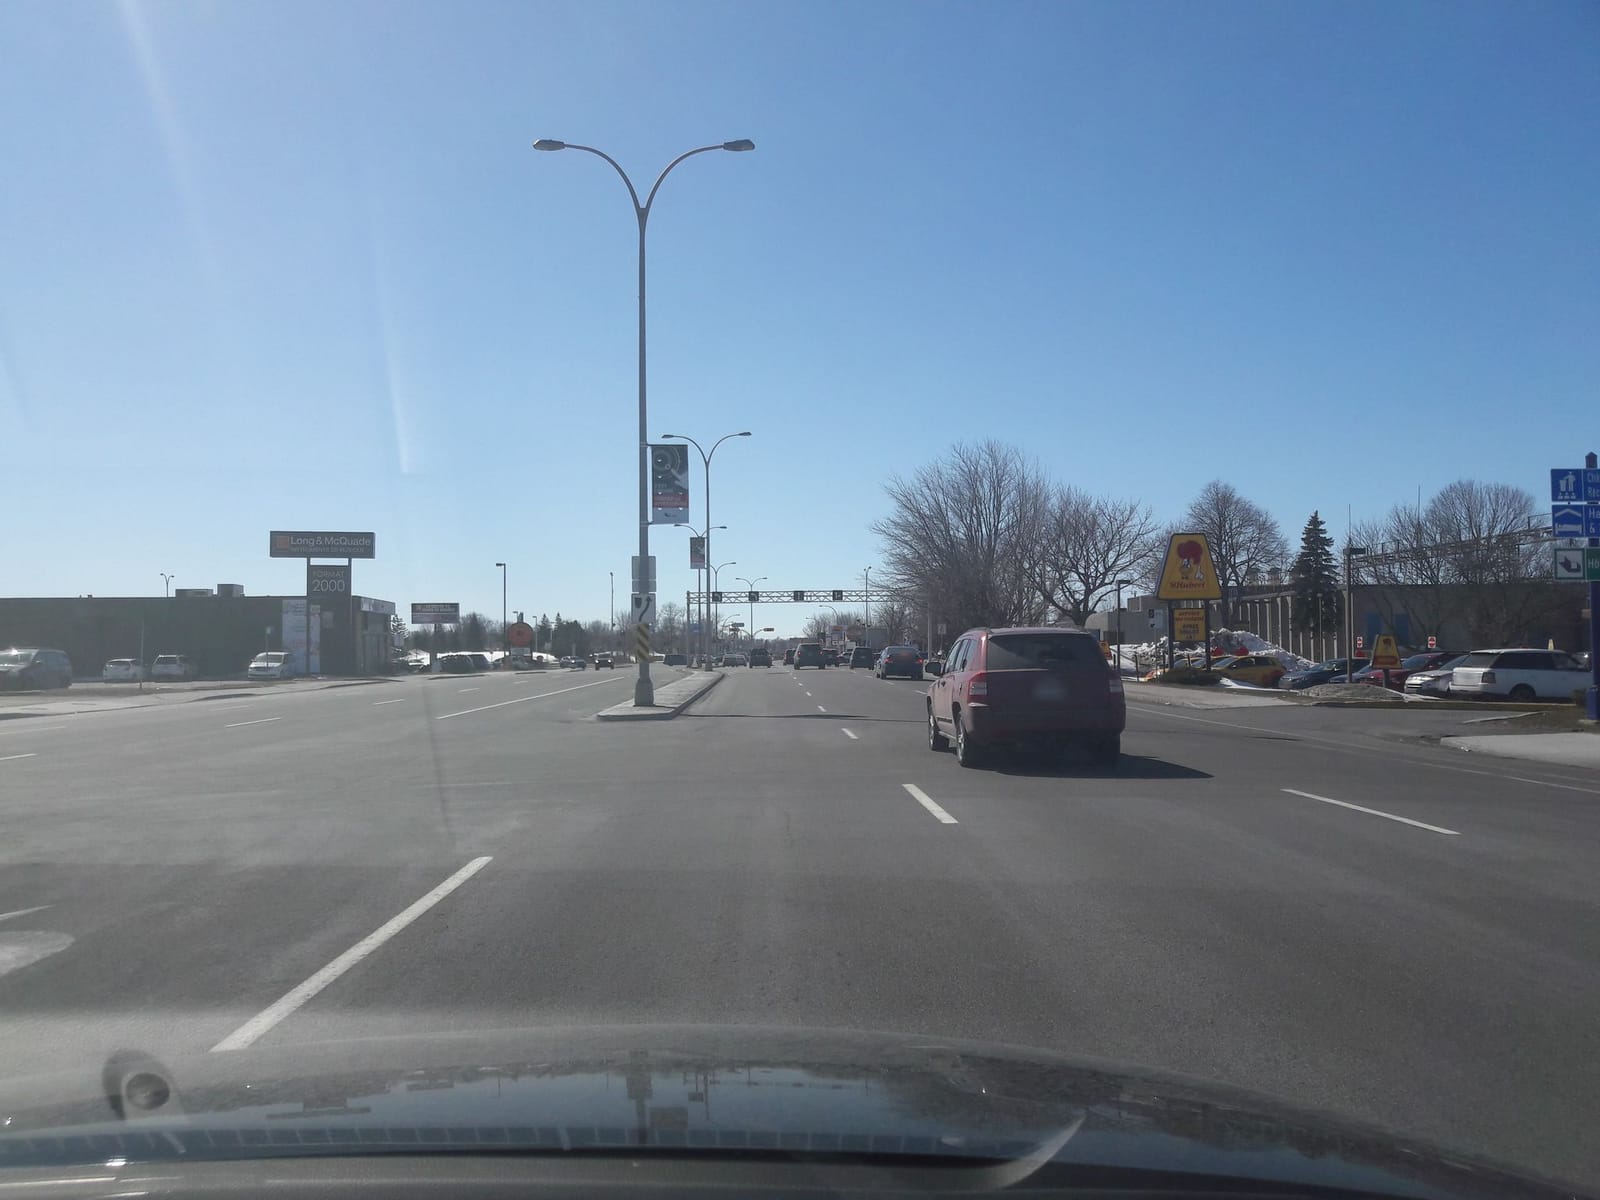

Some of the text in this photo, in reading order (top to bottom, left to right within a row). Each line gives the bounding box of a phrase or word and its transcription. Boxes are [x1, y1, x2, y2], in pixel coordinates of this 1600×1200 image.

[290, 536, 315, 547] Long
[324, 536, 371, 547] McQuade
[312, 579, 345, 592] 2000
